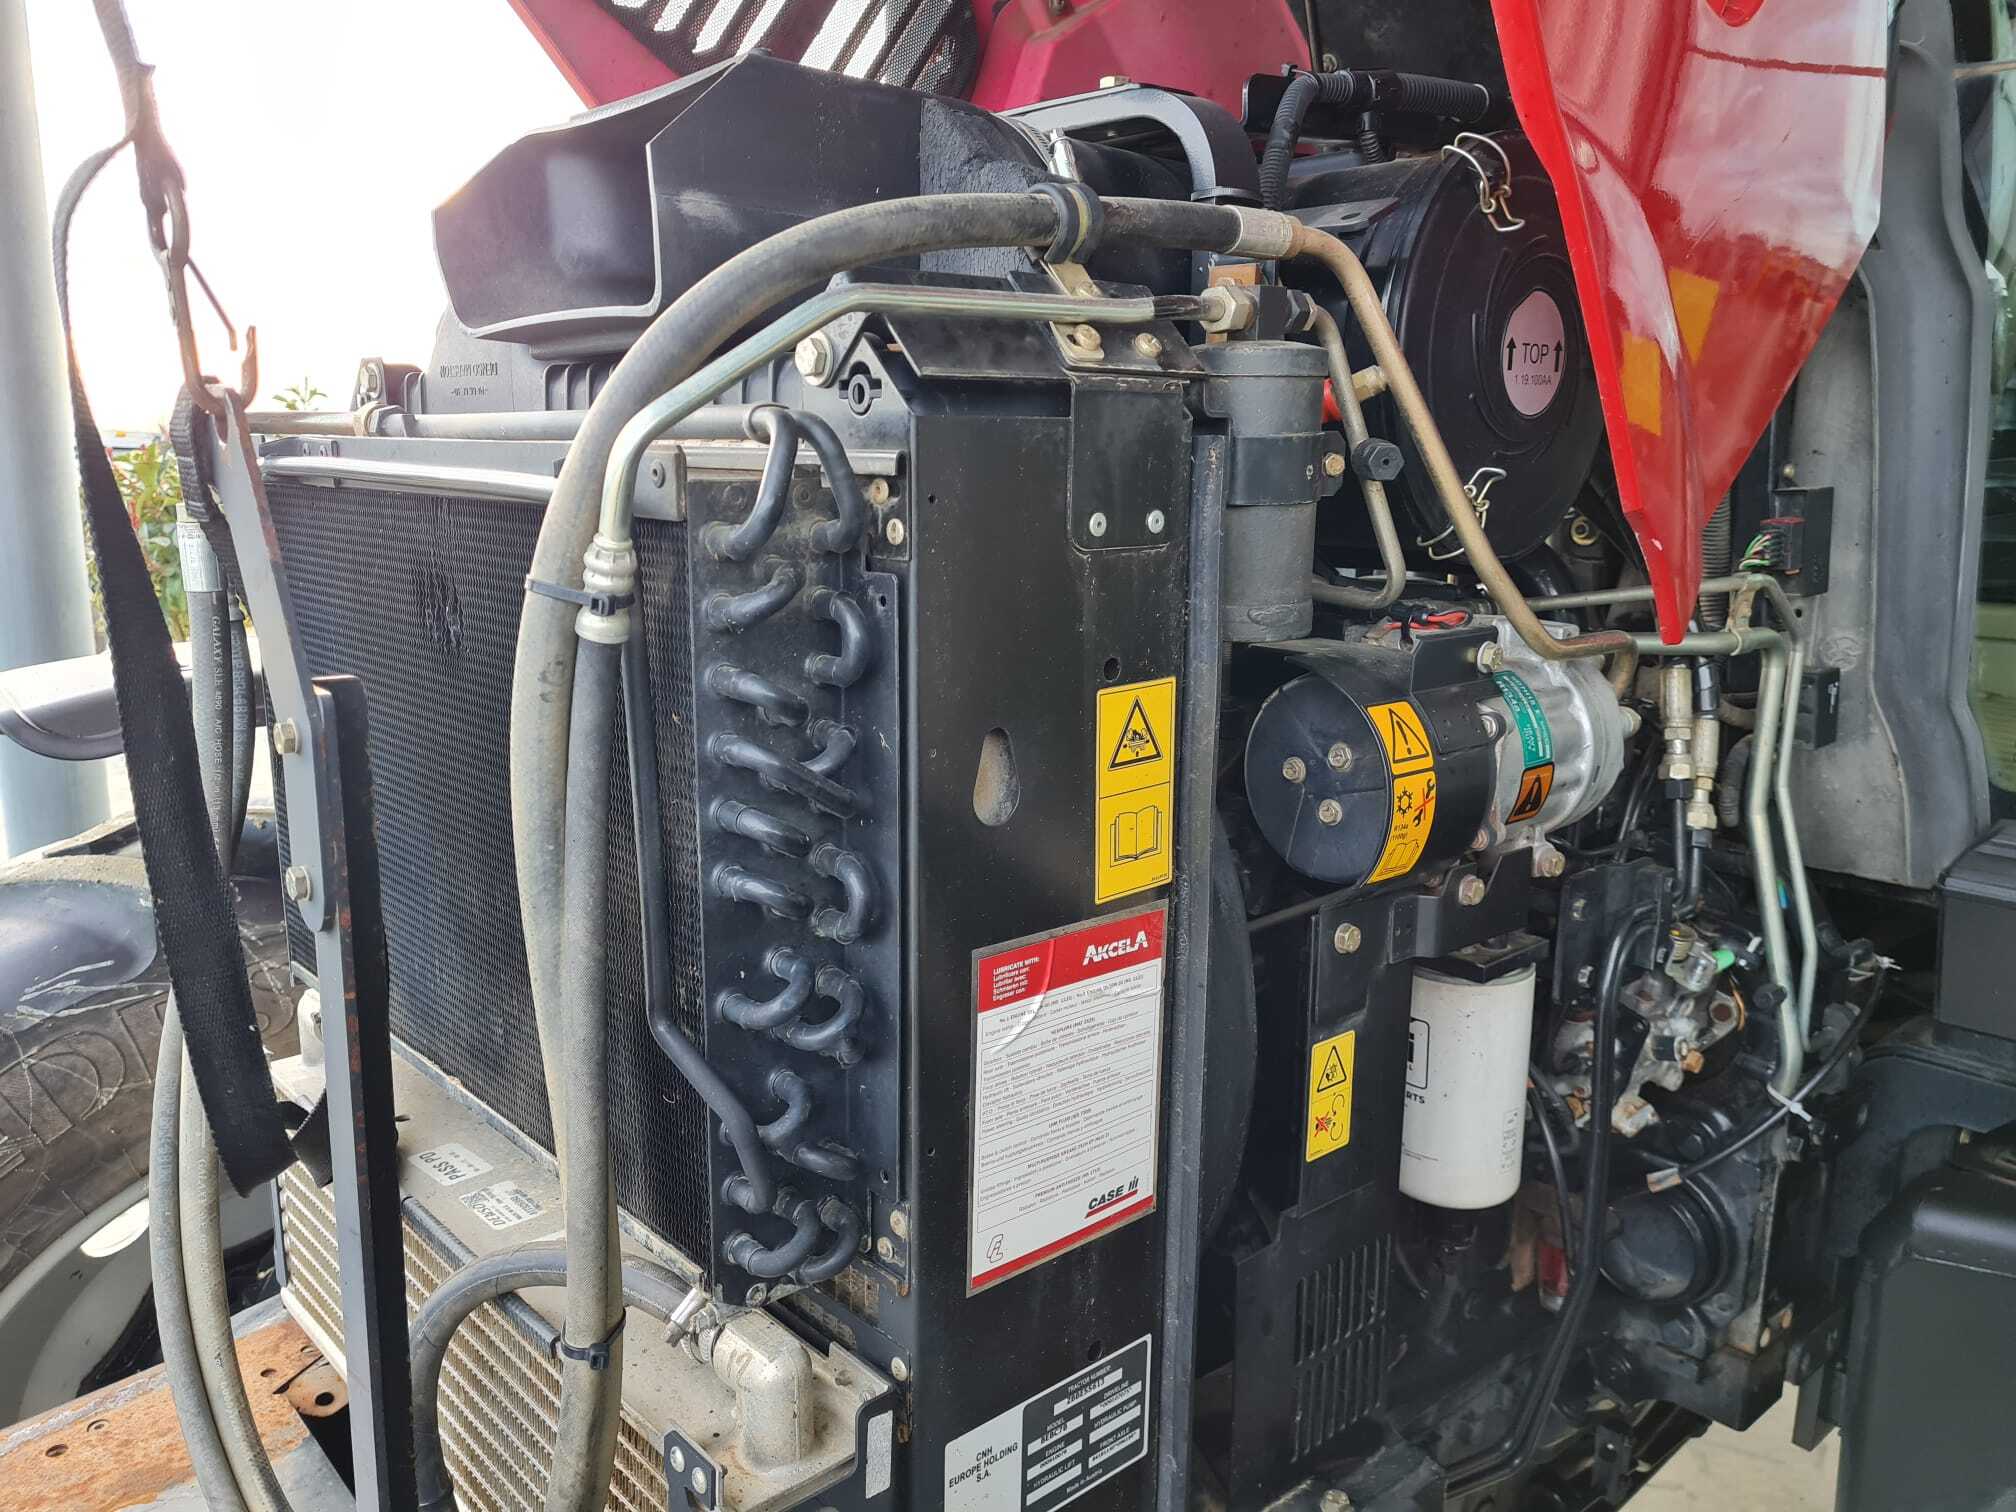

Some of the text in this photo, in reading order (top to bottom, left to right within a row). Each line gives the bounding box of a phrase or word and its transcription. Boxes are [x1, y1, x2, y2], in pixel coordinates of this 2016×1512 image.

[1522, 343, 1549, 364] TOP
[212, 615, 224, 664] GALAXY
[214, 738, 223, 764] HOSE
[1082, 930, 1149, 966] AKCELA
[1406, 1090, 1425, 1104] RTS
[433, 1161, 466, 1181] PASS
[1088, 1184, 1124, 1210] CASE
[472, 1202, 507, 1227] DENSO
[949, 1442, 1018, 1488] EUROPE HOLDING
[976, 1446, 993, 1462] CNH
[976, 1469, 991, 1483] S.A.
